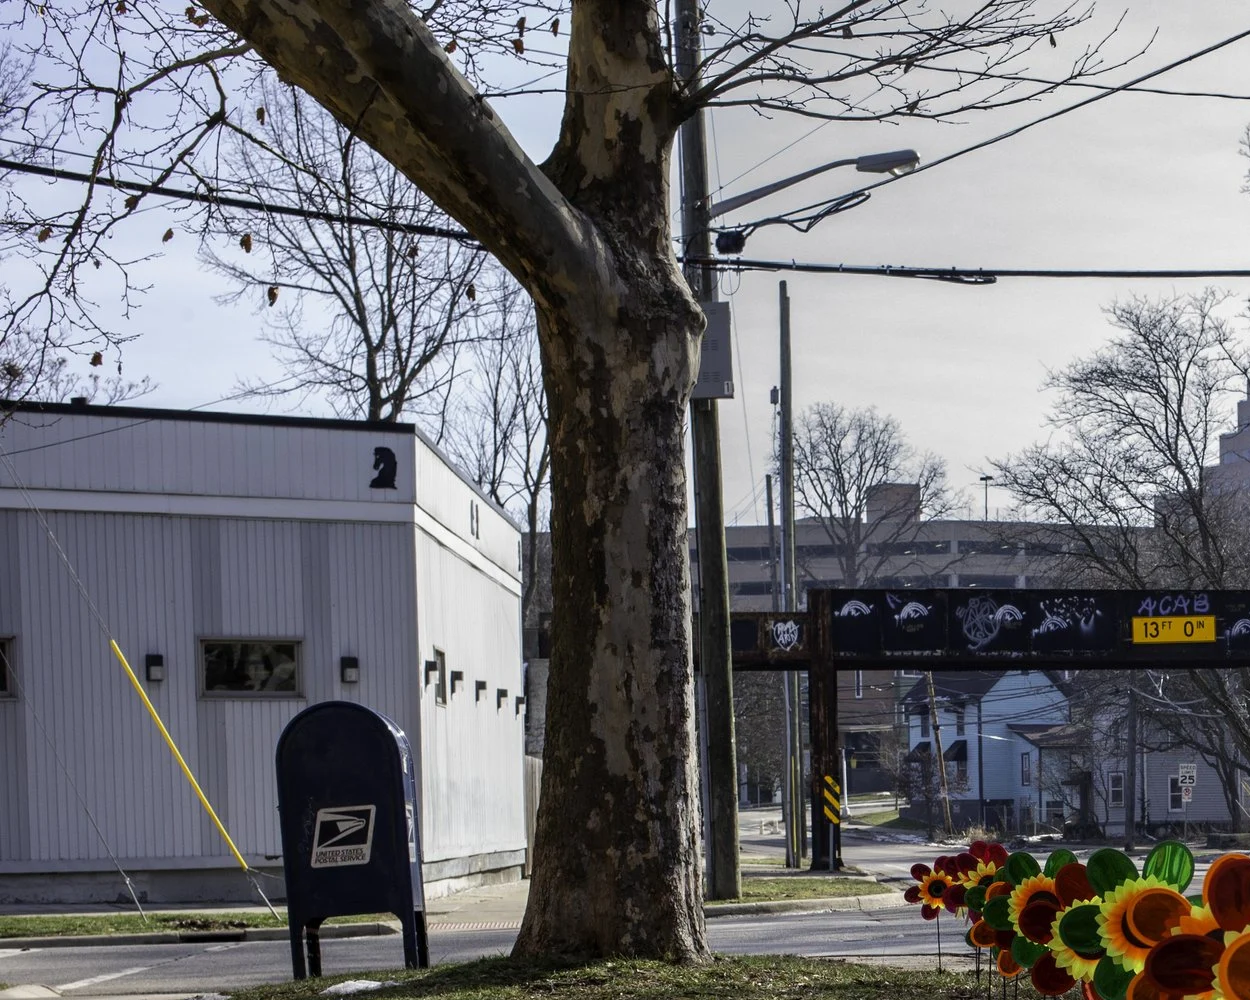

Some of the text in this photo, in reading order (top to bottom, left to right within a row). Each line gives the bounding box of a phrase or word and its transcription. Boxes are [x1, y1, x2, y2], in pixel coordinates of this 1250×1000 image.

[1137, 594, 1210, 617] ACAB
[1180, 775, 1195, 784] 25
[316, 849, 340, 857] UNITED
[340, 854, 366, 862] SERVICE
